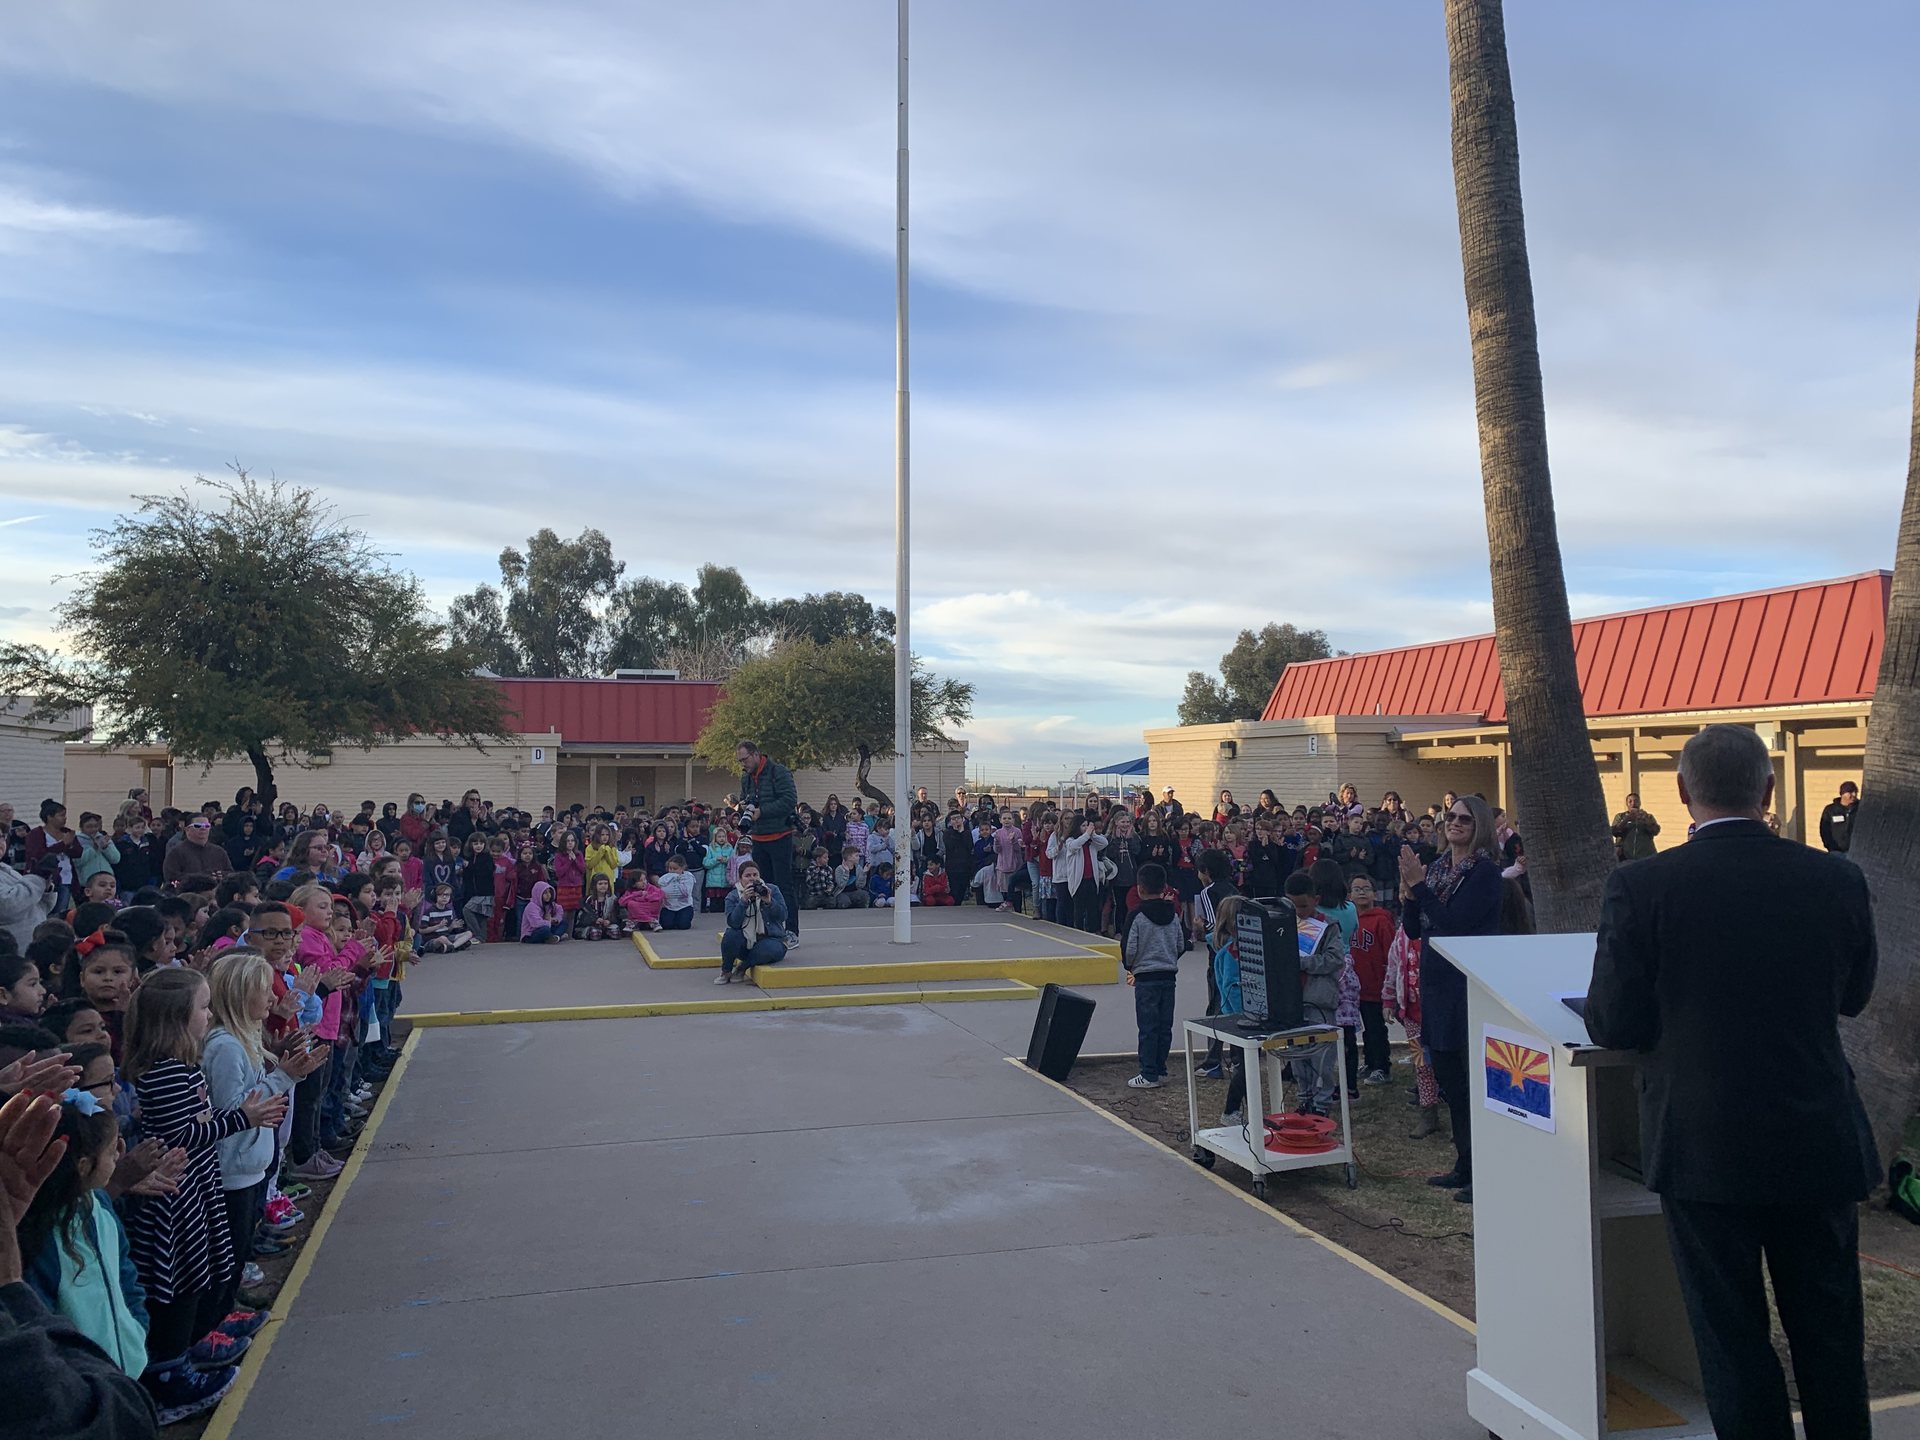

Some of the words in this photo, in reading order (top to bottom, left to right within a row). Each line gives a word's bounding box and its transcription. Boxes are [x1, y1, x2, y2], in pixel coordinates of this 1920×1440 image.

[1310, 737, 1316, 751] E
[535, 749, 542, 760] D
[1351, 928, 1375, 952] AP
